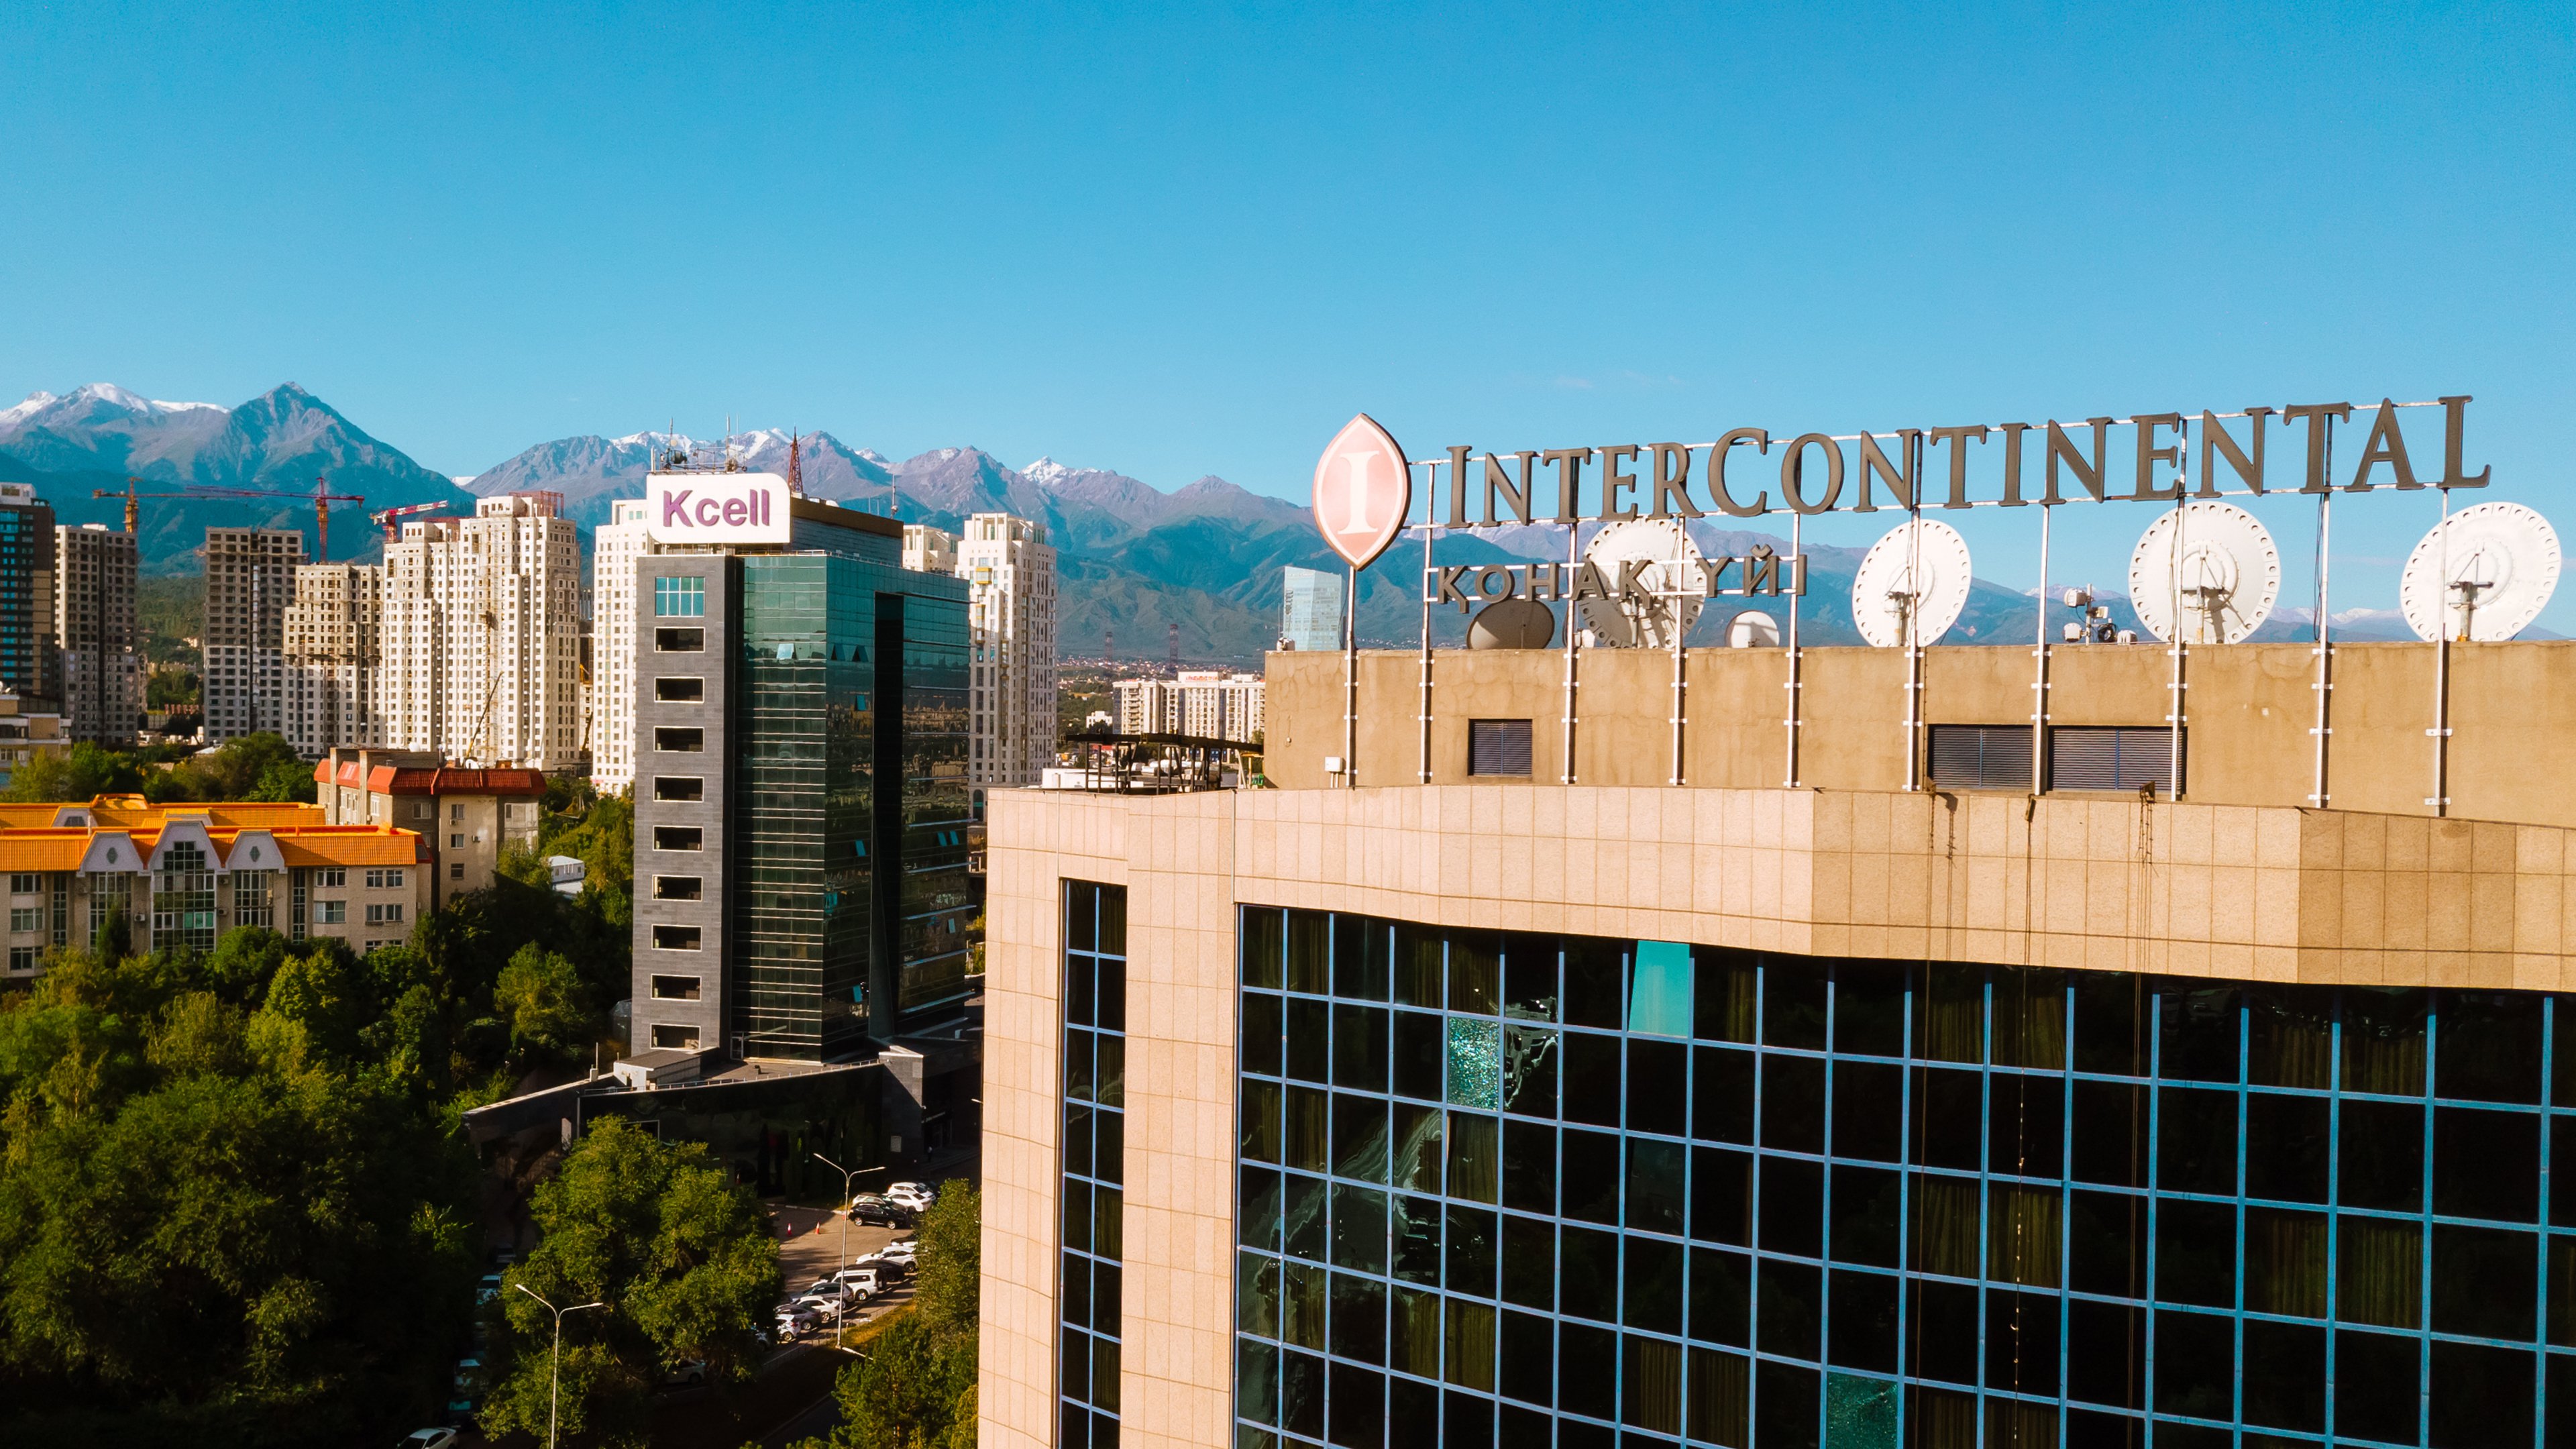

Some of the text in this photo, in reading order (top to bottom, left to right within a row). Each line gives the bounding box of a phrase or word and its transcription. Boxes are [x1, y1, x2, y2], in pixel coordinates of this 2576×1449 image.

[1338, 450, 1380, 535] I
[1446, 395, 2491, 529] INTERCONTINENTAL
[663, 488, 770, 527] Kcell
